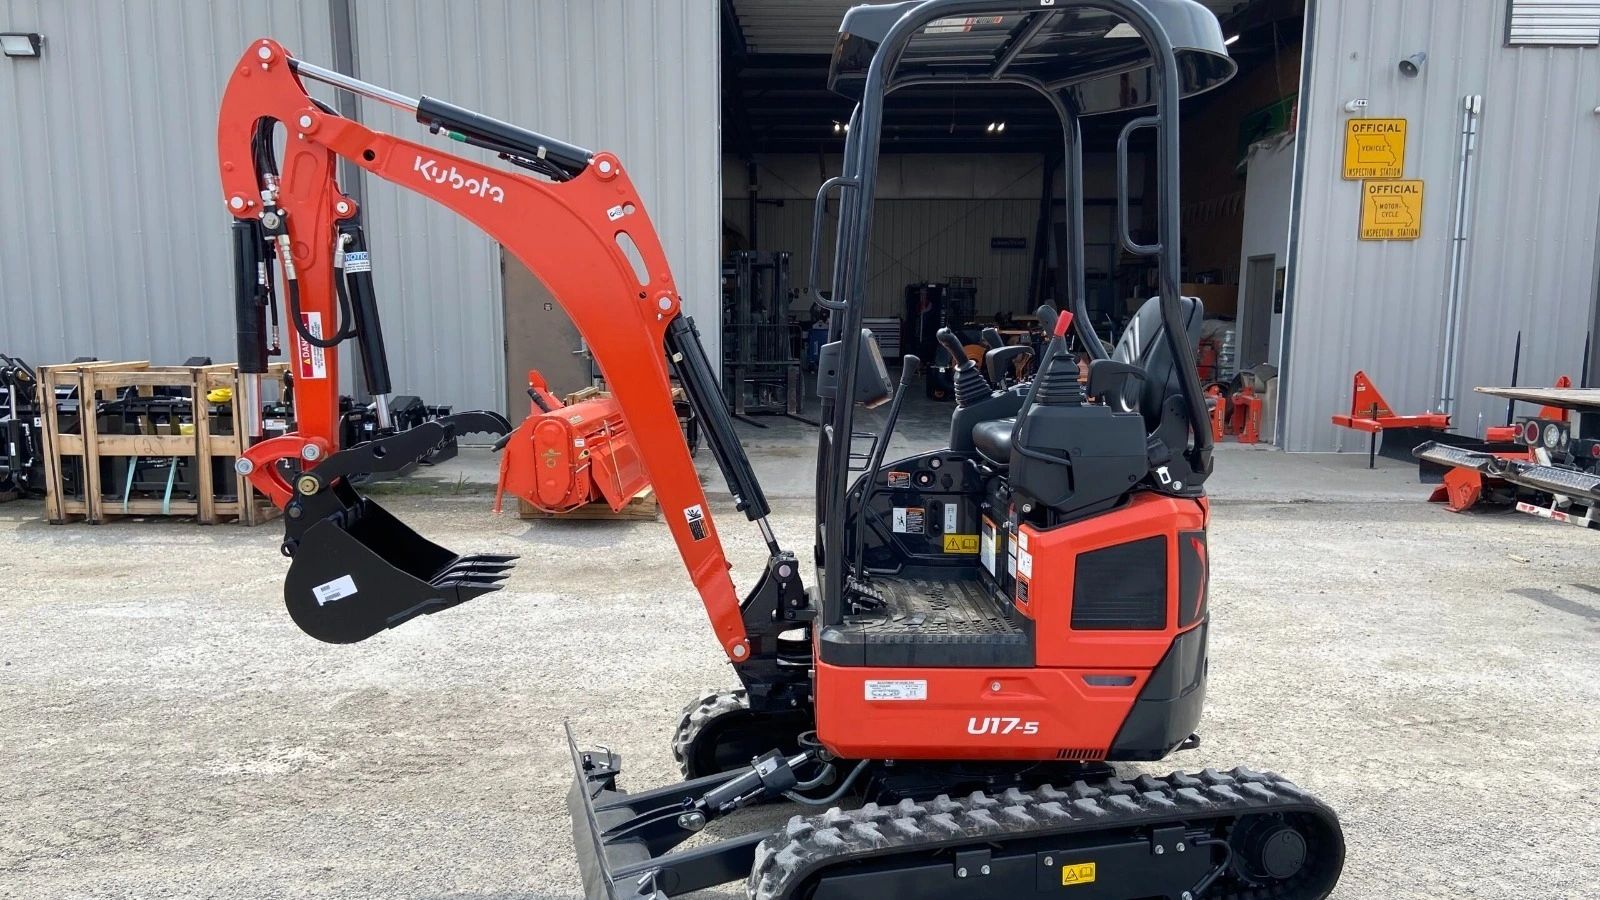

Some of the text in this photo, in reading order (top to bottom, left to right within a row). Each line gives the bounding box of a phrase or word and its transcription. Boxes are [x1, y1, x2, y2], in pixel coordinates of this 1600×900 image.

[1352, 124, 1401, 133] OFFICIAL
[1346, 167, 1401, 177] INSPECTION STATION
[413, 155, 505, 204] Kubota
[1369, 185, 1419, 194] OFFICIAL
[1364, 228, 1418, 238] INSPECTION STATION
[345, 253, 369, 261] NOTIC
[967, 717, 1040, 735] U17-5
